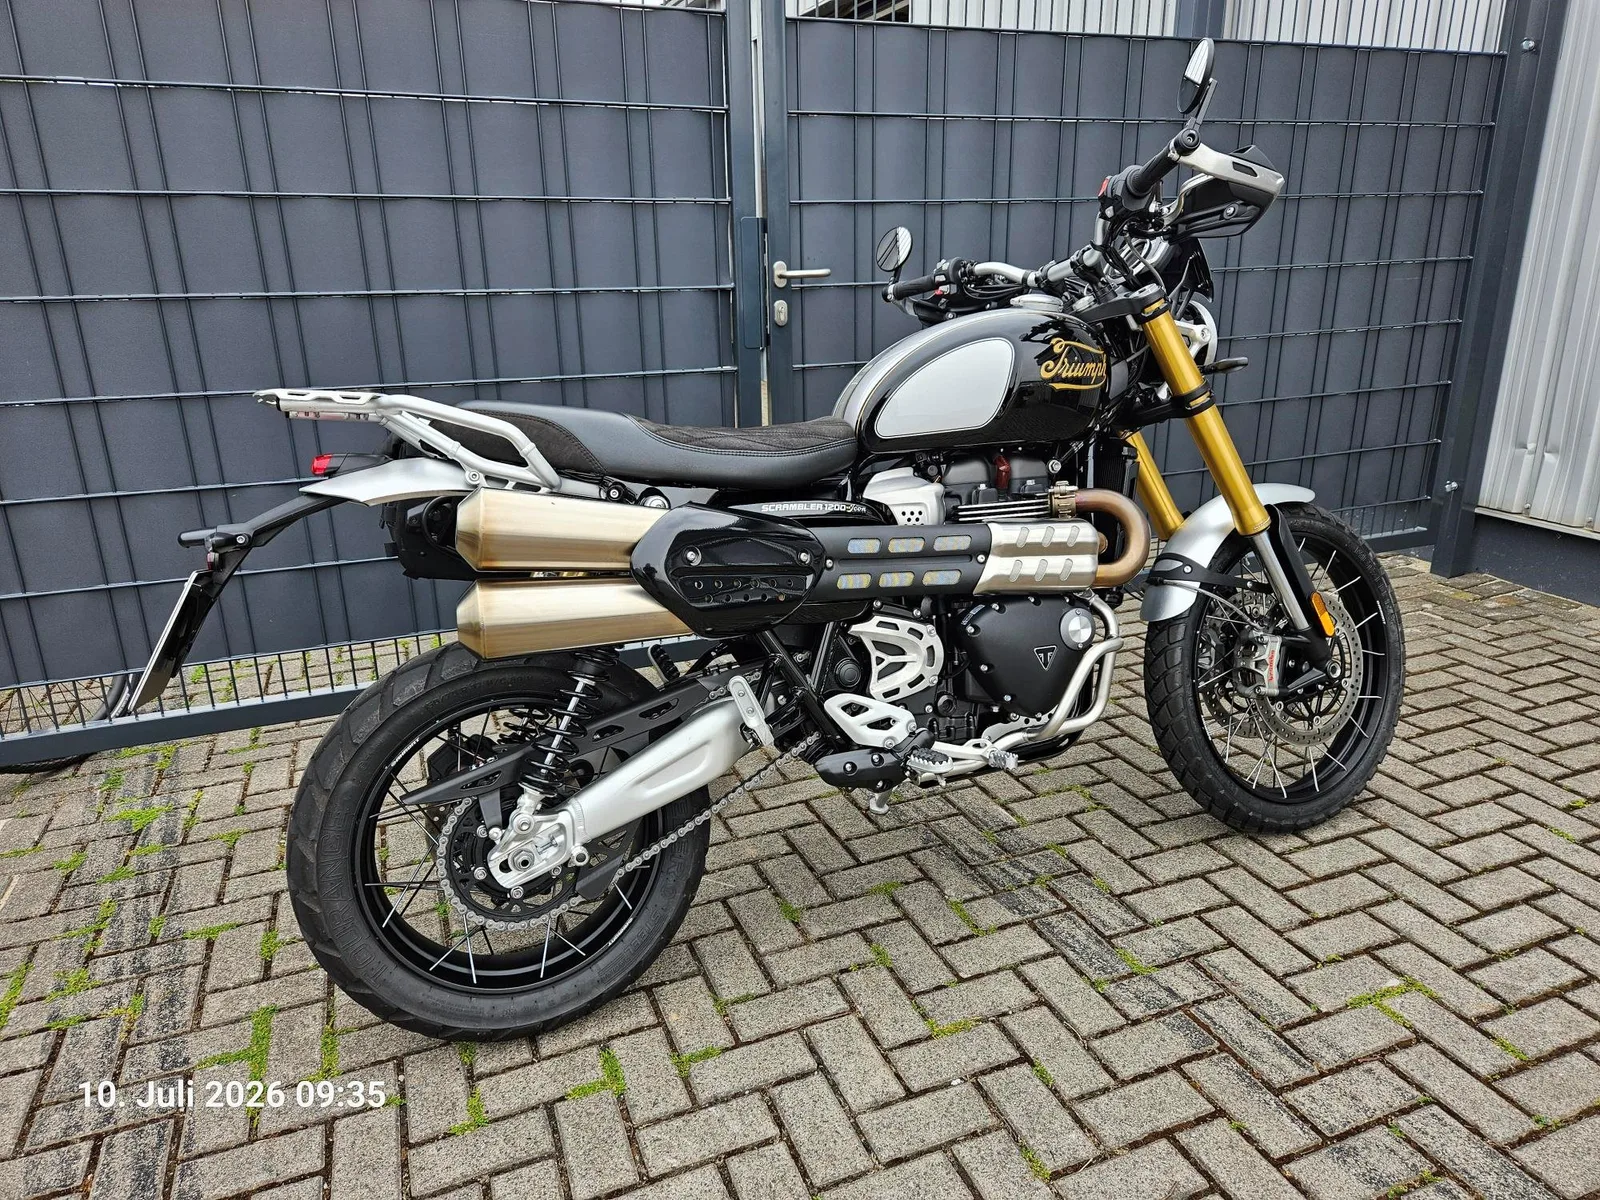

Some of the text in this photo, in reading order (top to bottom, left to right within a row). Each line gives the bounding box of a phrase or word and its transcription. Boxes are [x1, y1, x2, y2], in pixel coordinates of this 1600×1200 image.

[1041, 338, 1106, 390] Triumph
[761, 503, 823, 512] SCRAMBLER
[824, 503, 846, 511] 1200
